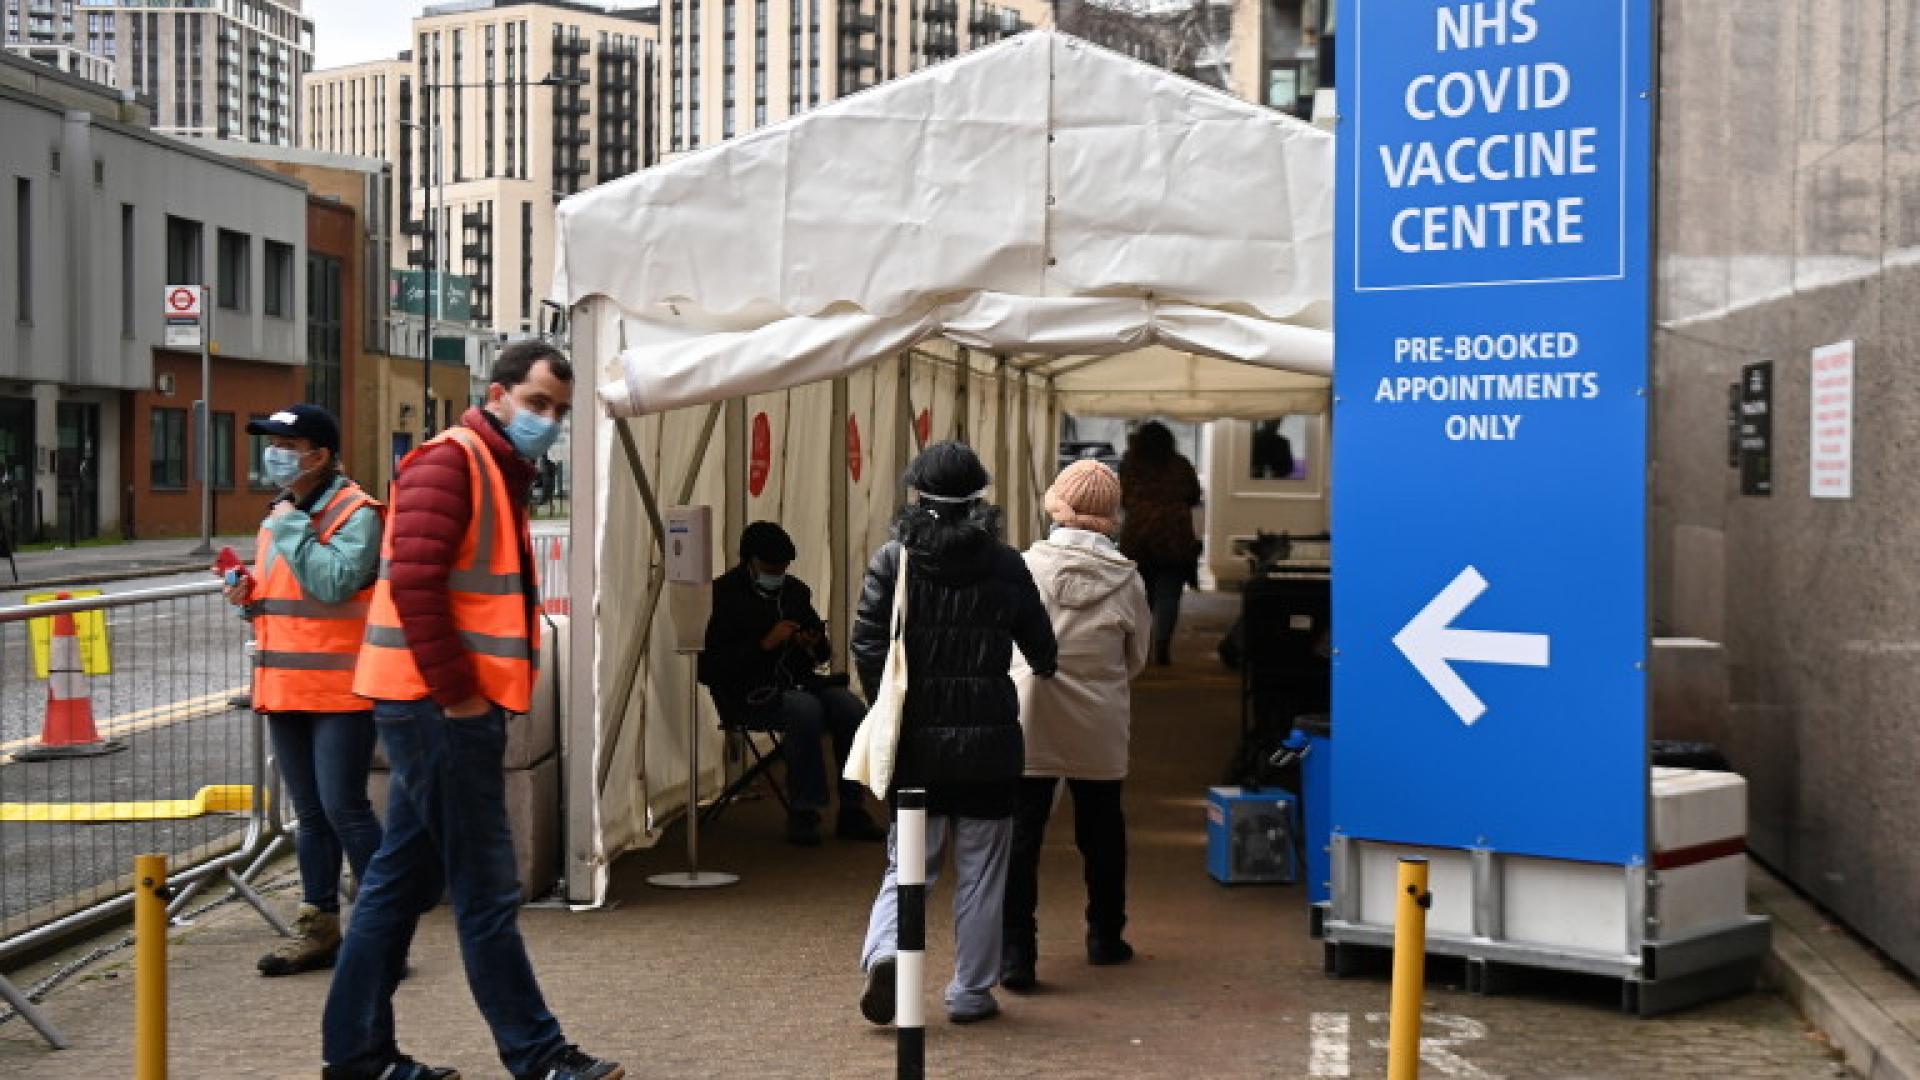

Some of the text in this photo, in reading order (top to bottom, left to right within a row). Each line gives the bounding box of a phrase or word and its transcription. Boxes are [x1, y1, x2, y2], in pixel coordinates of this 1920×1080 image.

[1437, 0, 1538, 51] NHS
[1405, 62, 1570, 120] COVID
[1380, 127, 1596, 188] VACCINE
[1392, 197, 1583, 252] CENTRE
[1395, 332, 1578, 362] PRE-BOOKED
[1375, 372, 1599, 401] APPOINTMENTS
[1445, 415, 1520, 440] ONLY
